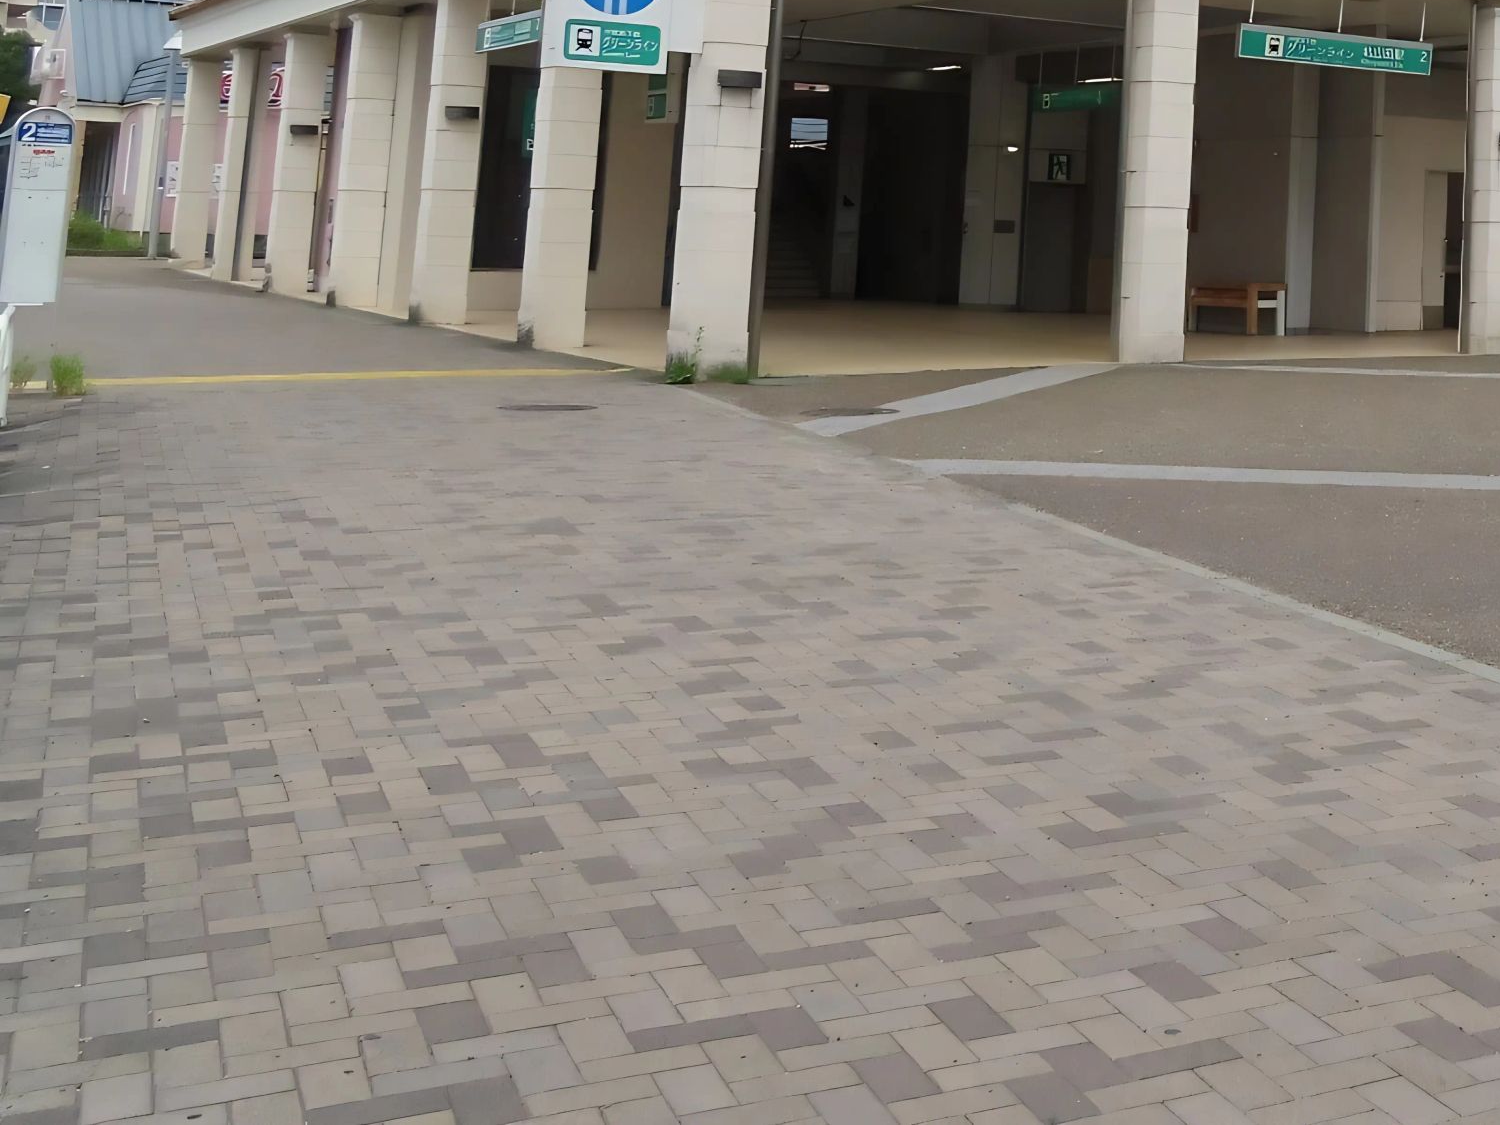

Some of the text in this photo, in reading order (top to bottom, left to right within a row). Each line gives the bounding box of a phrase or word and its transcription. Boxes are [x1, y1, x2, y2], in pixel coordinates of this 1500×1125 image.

[602, 36, 658, 52] グリーンライン
[1419, 50, 1428, 63] 2
[21, 122, 37, 141] 2
